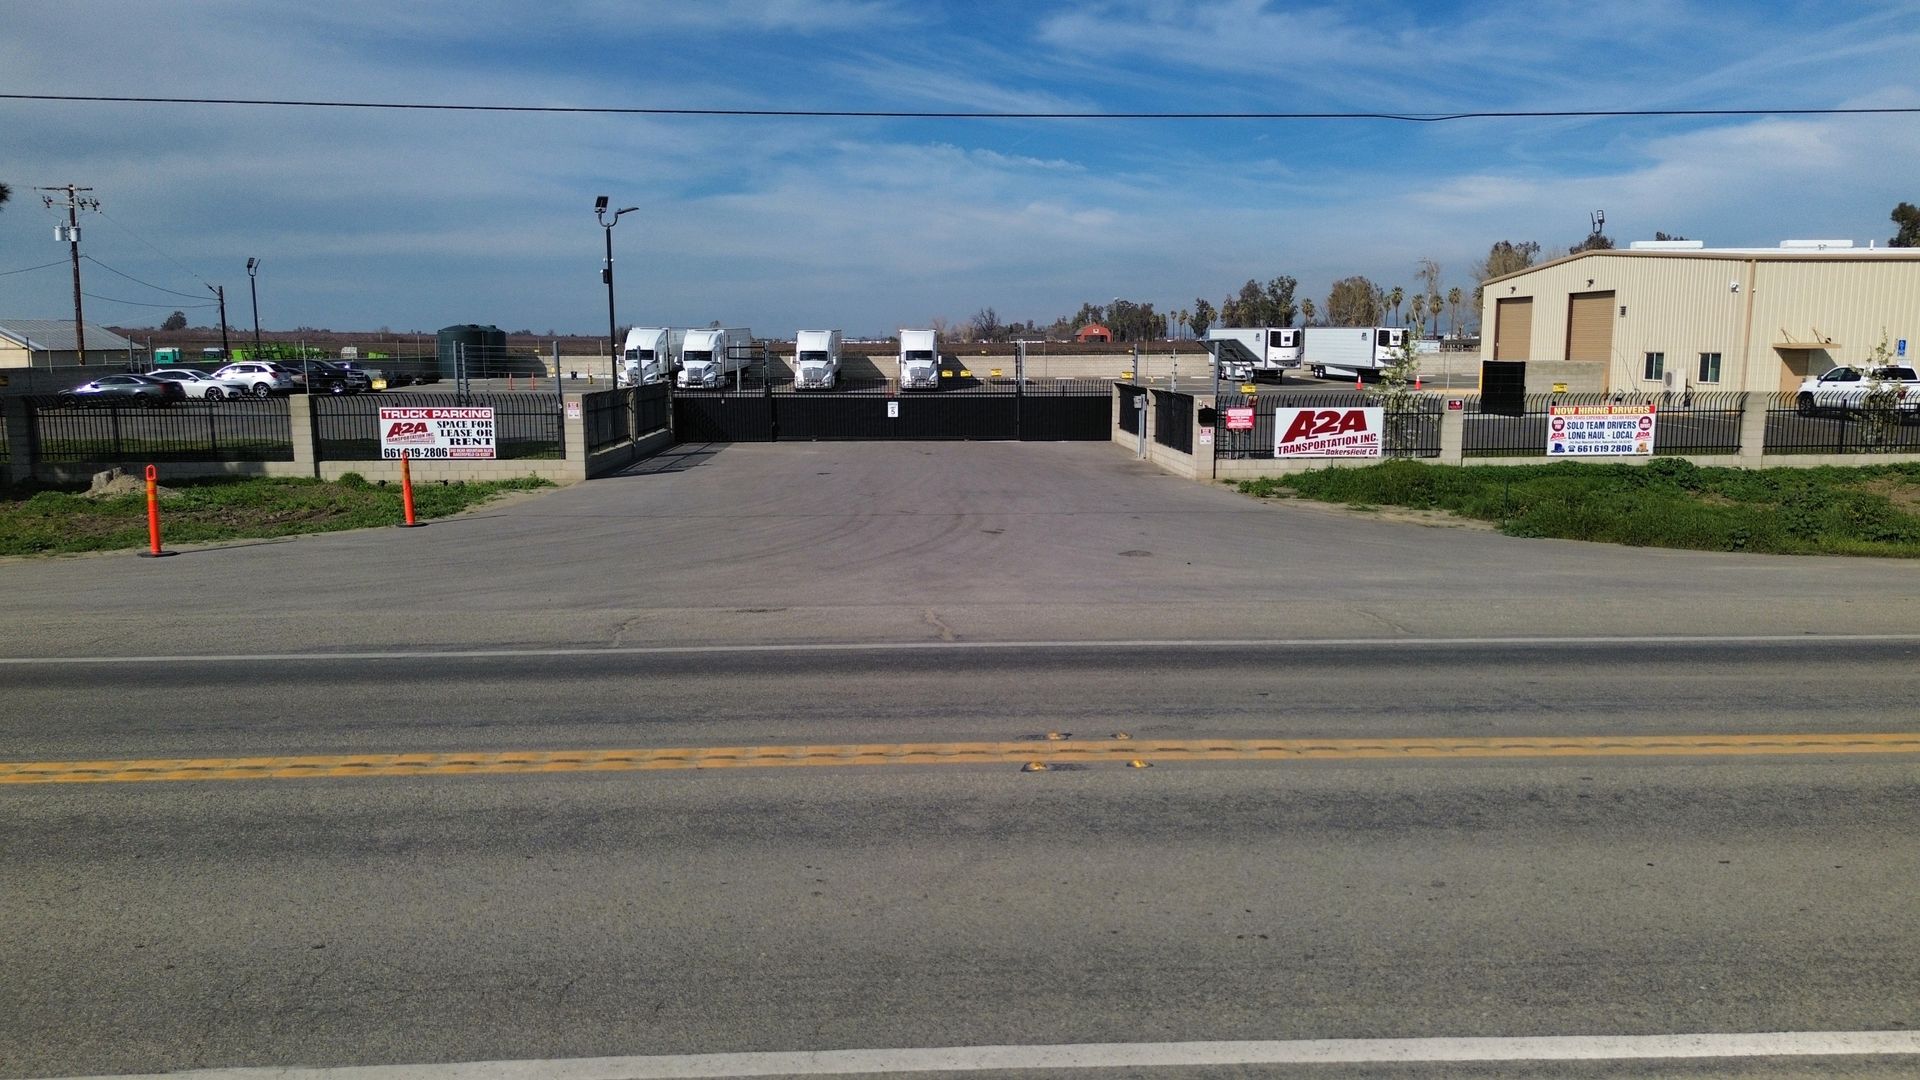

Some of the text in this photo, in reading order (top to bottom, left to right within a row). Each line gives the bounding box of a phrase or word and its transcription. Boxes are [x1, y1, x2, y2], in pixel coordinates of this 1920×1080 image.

[382, 410, 492, 418] TRUCK PARKING
[1554, 407, 1576, 415] NOW
[1578, 406, 1609, 414] HIRING
[386, 422, 428, 438] A2A
[1280, 410, 1368, 444] A2A
[1607, 421, 1636, 429] DRIVERS
[1278, 434, 1378, 454] TRANSPORTATION INC.
